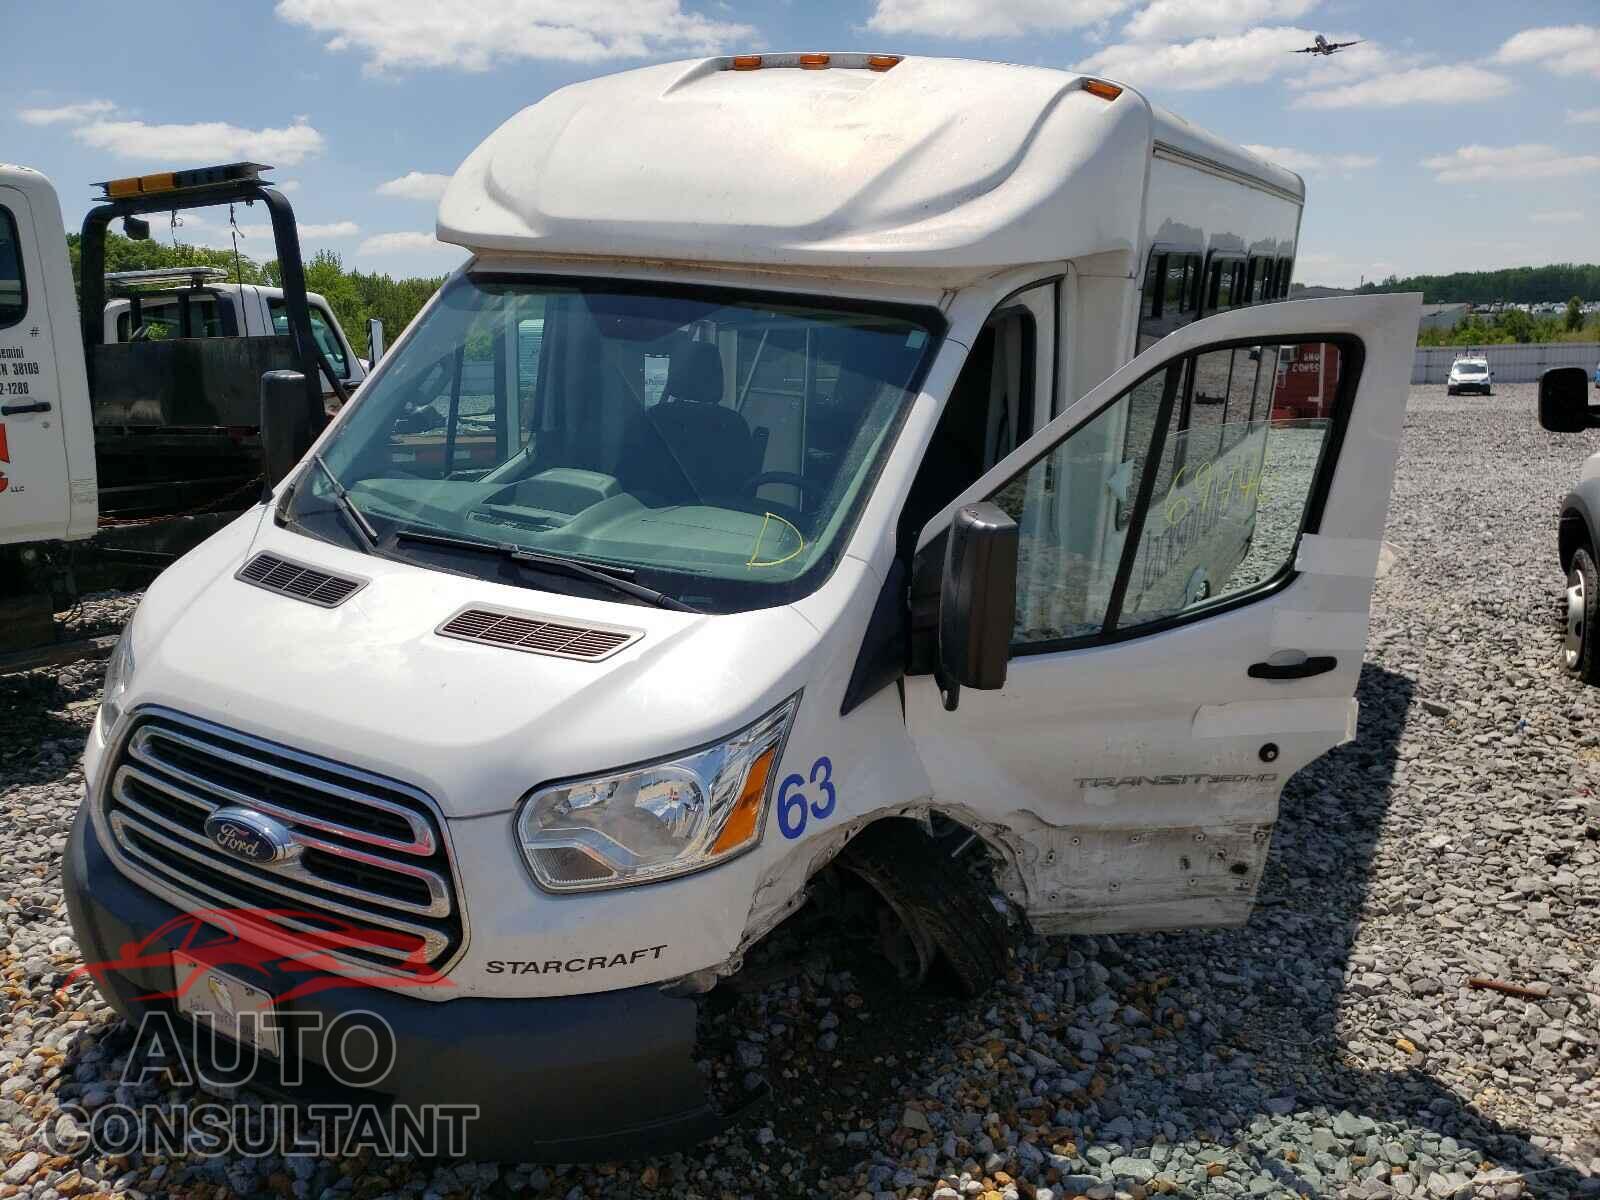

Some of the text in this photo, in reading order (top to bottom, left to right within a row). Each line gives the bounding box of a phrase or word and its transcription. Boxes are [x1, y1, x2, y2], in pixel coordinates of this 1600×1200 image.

[0, 345, 25, 359] emini
[12, 361, 40, 376] 38109
[745, 511, 804, 568] D
[1073, 773, 1209, 789] TRANSIT
[777, 756, 836, 840] 63
[216, 823, 261, 857] Ford
[485, 944, 668, 975] STARCRAFT
